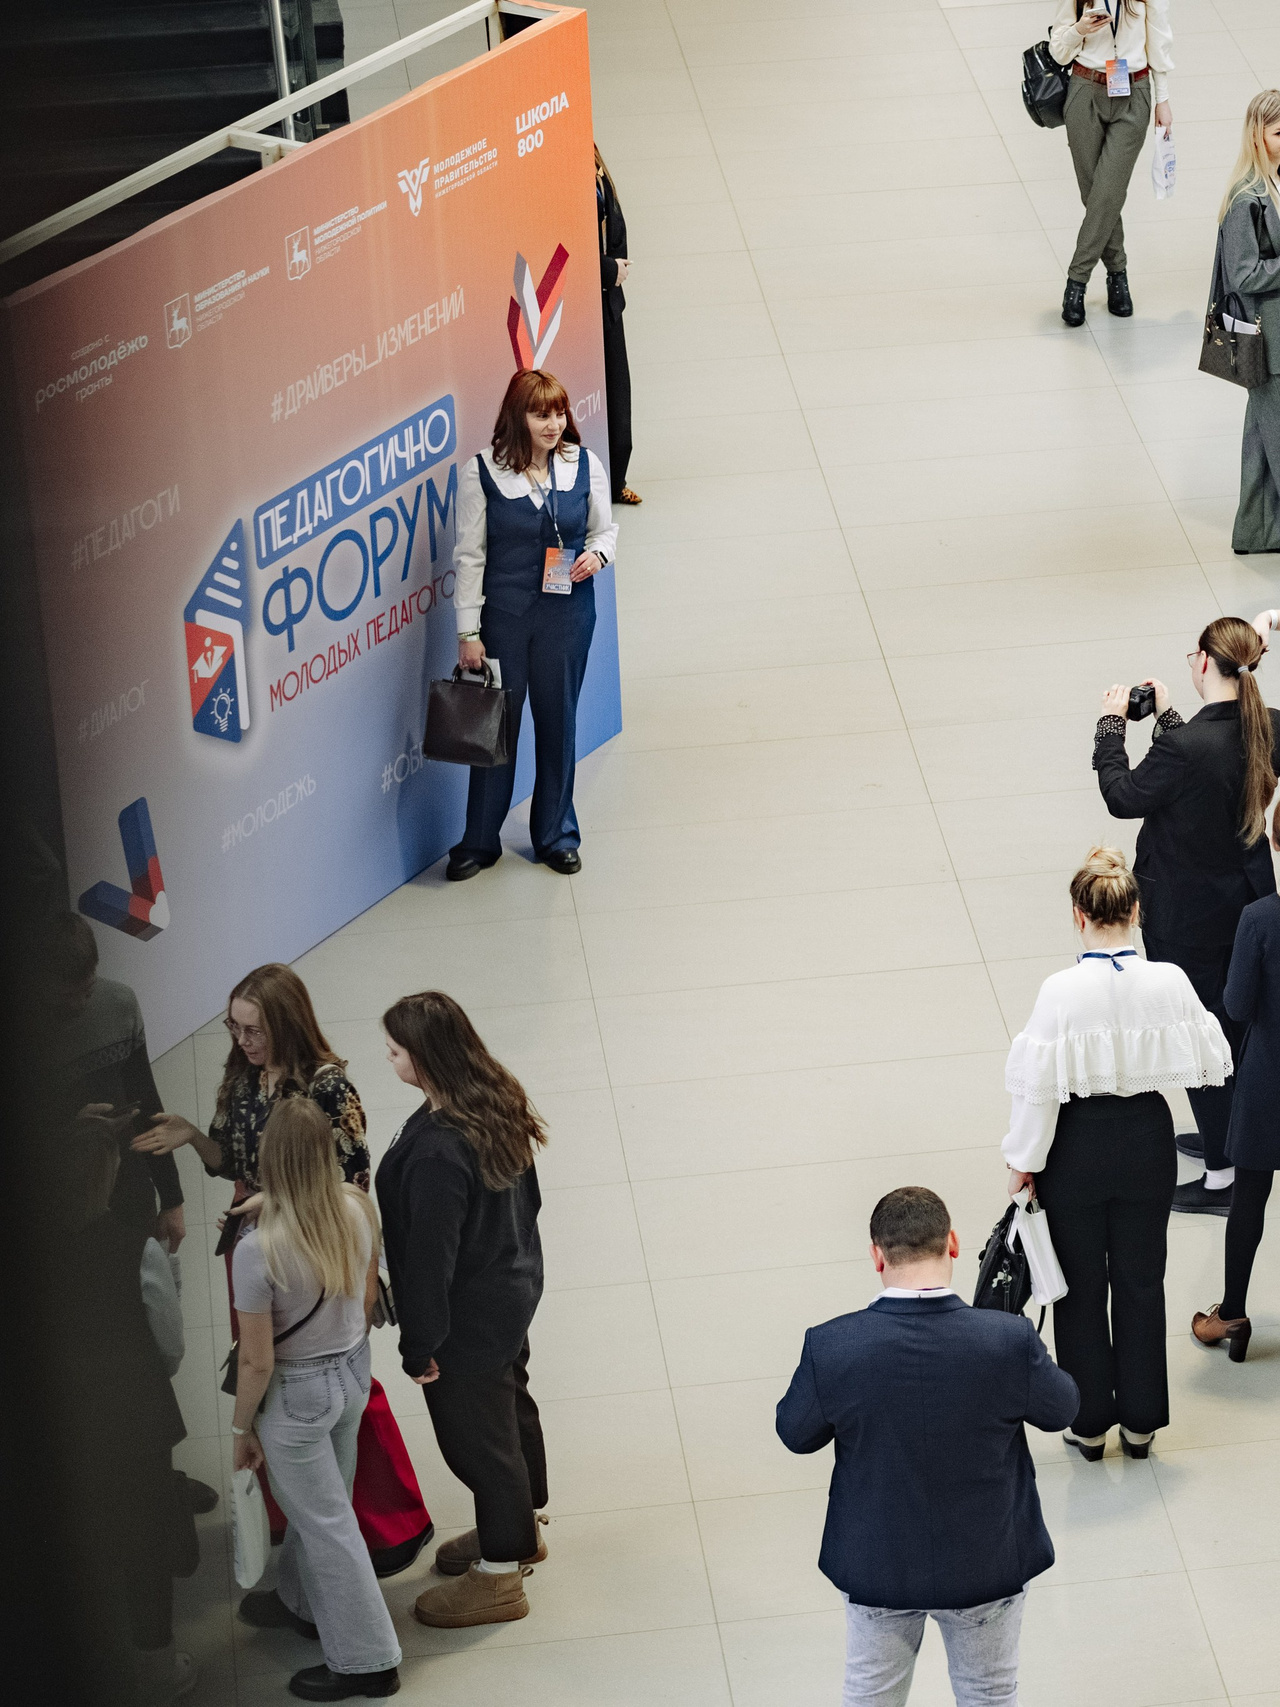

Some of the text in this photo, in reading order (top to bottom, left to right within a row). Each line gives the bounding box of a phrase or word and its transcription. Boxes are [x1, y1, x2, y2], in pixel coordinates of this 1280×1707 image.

[515, 91, 569, 135] ШКОЛА
[517, 129, 544, 158] 800
[433, 138, 488, 176] МОЛОДЕЖНОЕ
[434, 148, 498, 190] ПРАВИТЕЛЬСТВО
[434, 160, 498, 199] НИЖЕГОРОДСКОЙ ОБЛАСТИ
[35, 335, 149, 413] росмолодёжь
[271, 284, 466, 424] #ДРАЙВЕРЫ_ИЗМЕНЕНИЙ
[258, 408, 450, 559] ПЕДАГОГИЧНО
[71, 484, 181, 572] #ПЕДАГОГИ
[262, 462, 458, 653] ФОРУМ
[269, 569, 456, 713] МОЛОДЫХ ПЕДАГОГО
[221, 773, 316, 853] #МОЛОДЕЖЬ
